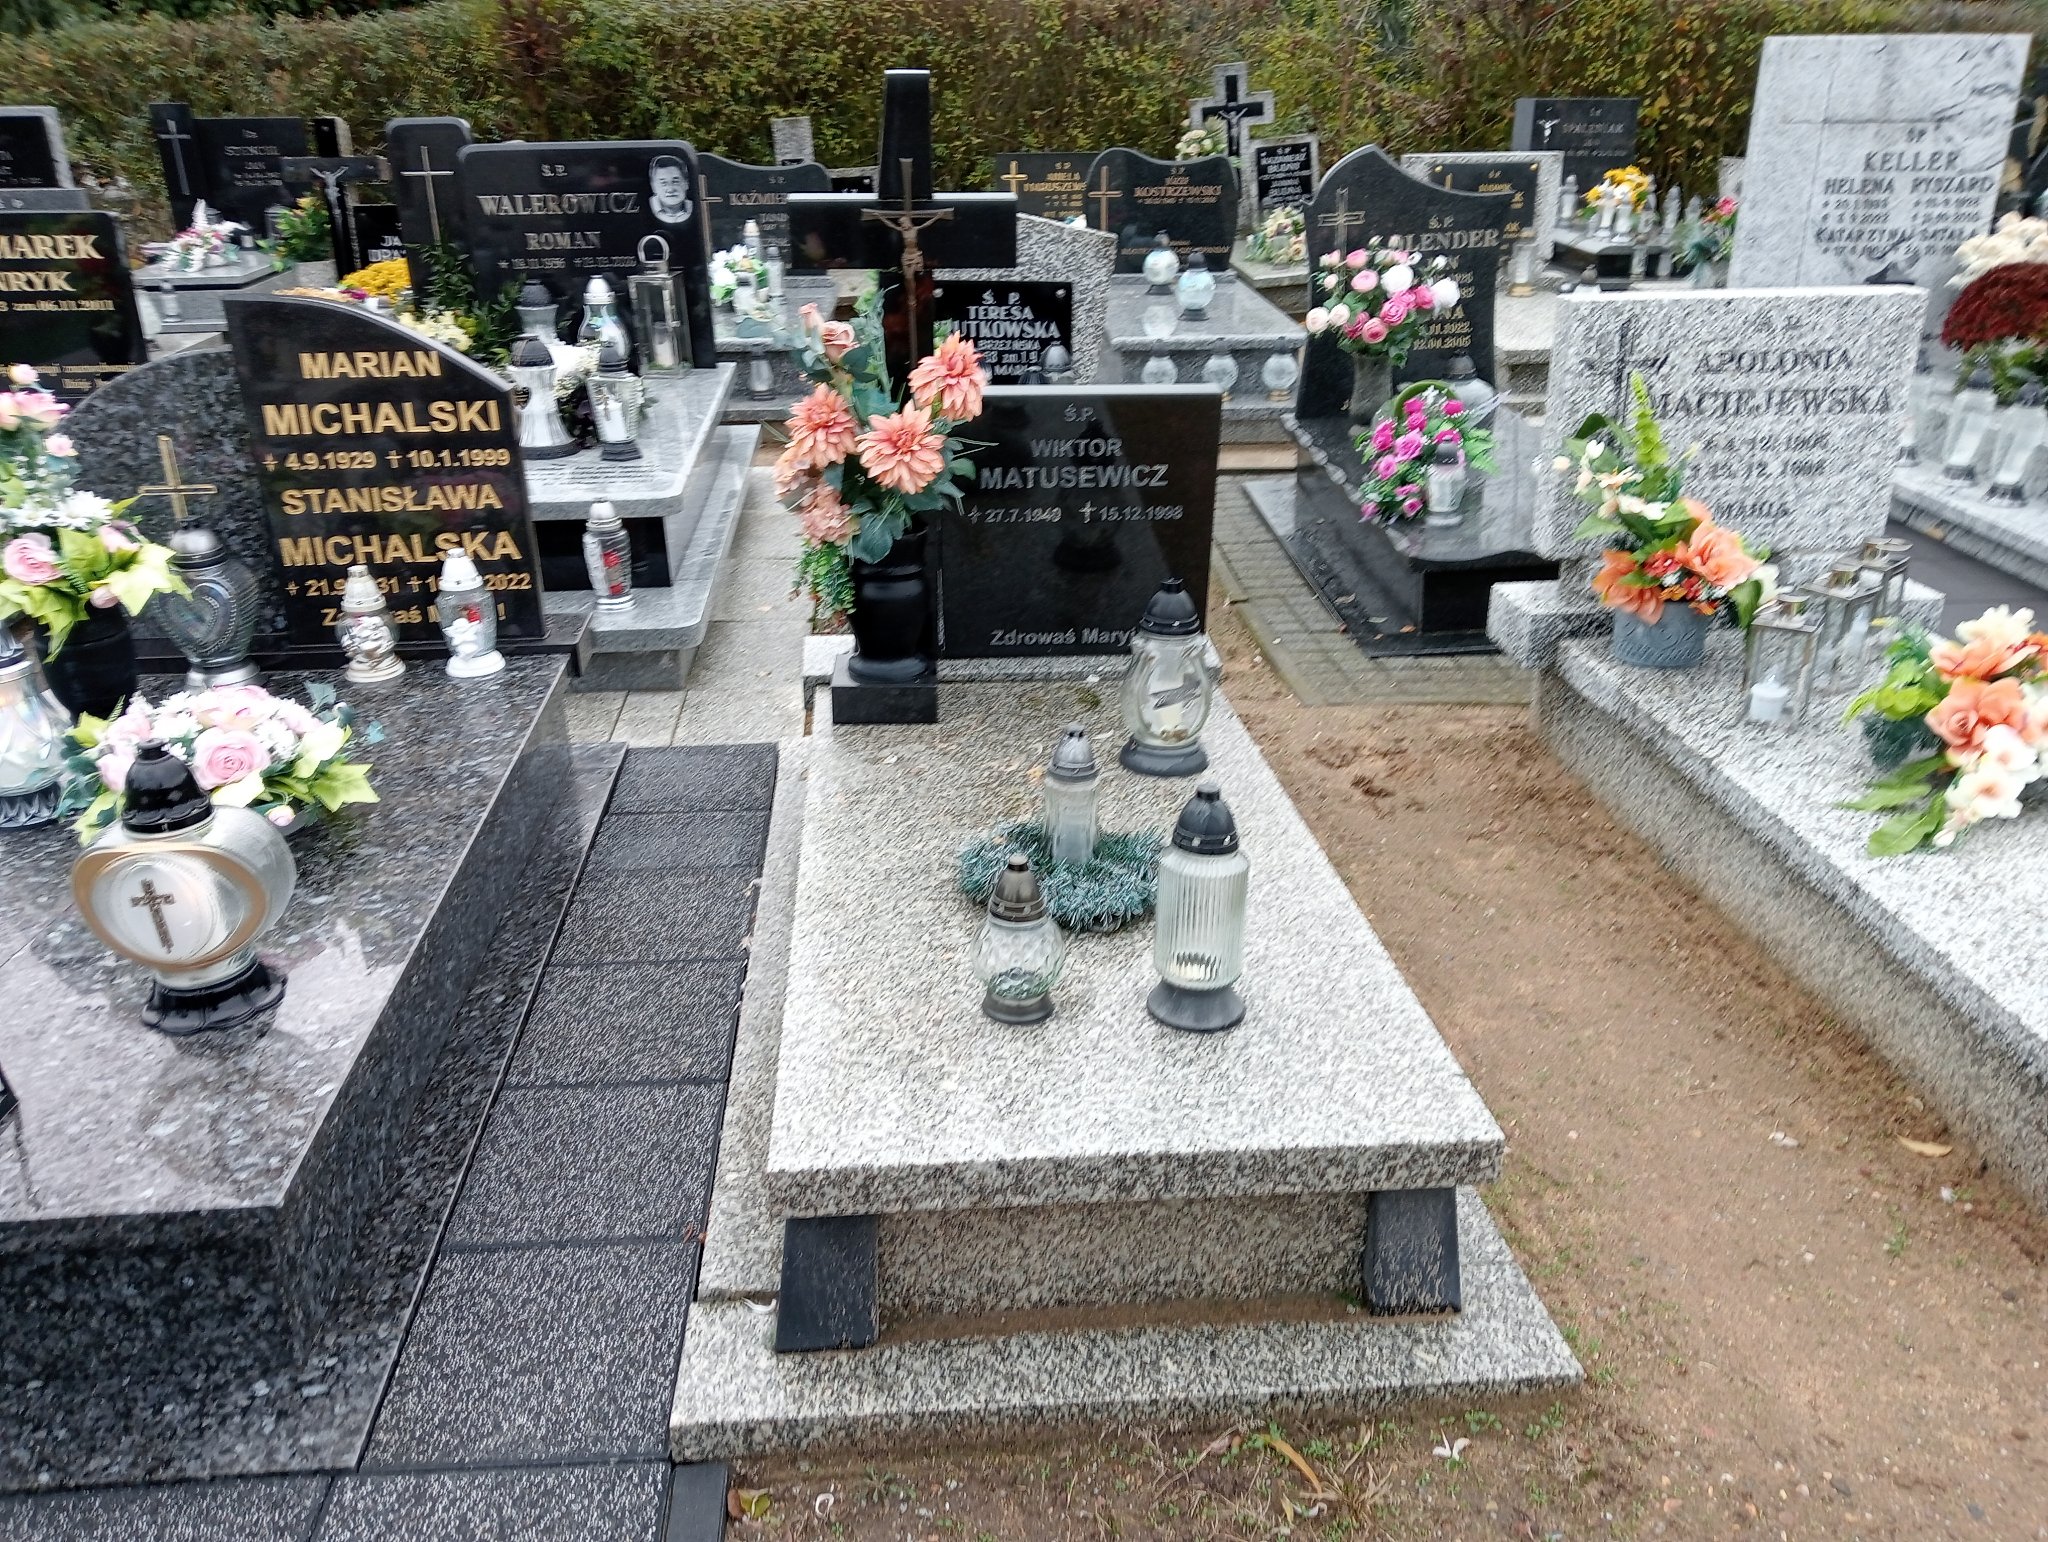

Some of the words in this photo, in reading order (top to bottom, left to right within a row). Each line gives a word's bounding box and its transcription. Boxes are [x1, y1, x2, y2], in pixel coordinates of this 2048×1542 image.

[1863, 151, 1959, 172] KELLER
[476, 192, 640, 216] WALEROWICZ
[524, 231, 601, 250] ROMAN
[1401, 229, 1500, 252] LENDER
[967, 305, 1034, 320] TERESA
[952, 320, 1061, 339] UTKOWSKA
[299, 351, 441, 379] MARIAN
[1694, 346, 1852, 376] APOLONIA
[261, 400, 501, 436] MICHALSKI
[283, 451, 377, 471] 4.9.1929
[406, 448, 511, 468] 10.1.1999
[1031, 438, 1123, 458] WIKTOR
[979, 464, 1169, 489] MATUSEWICZ
[280, 484, 503, 515] STANISŁAWA
[278, 531, 522, 567] MICHALSKA
[989, 628, 1077, 646] Zdrowaś
